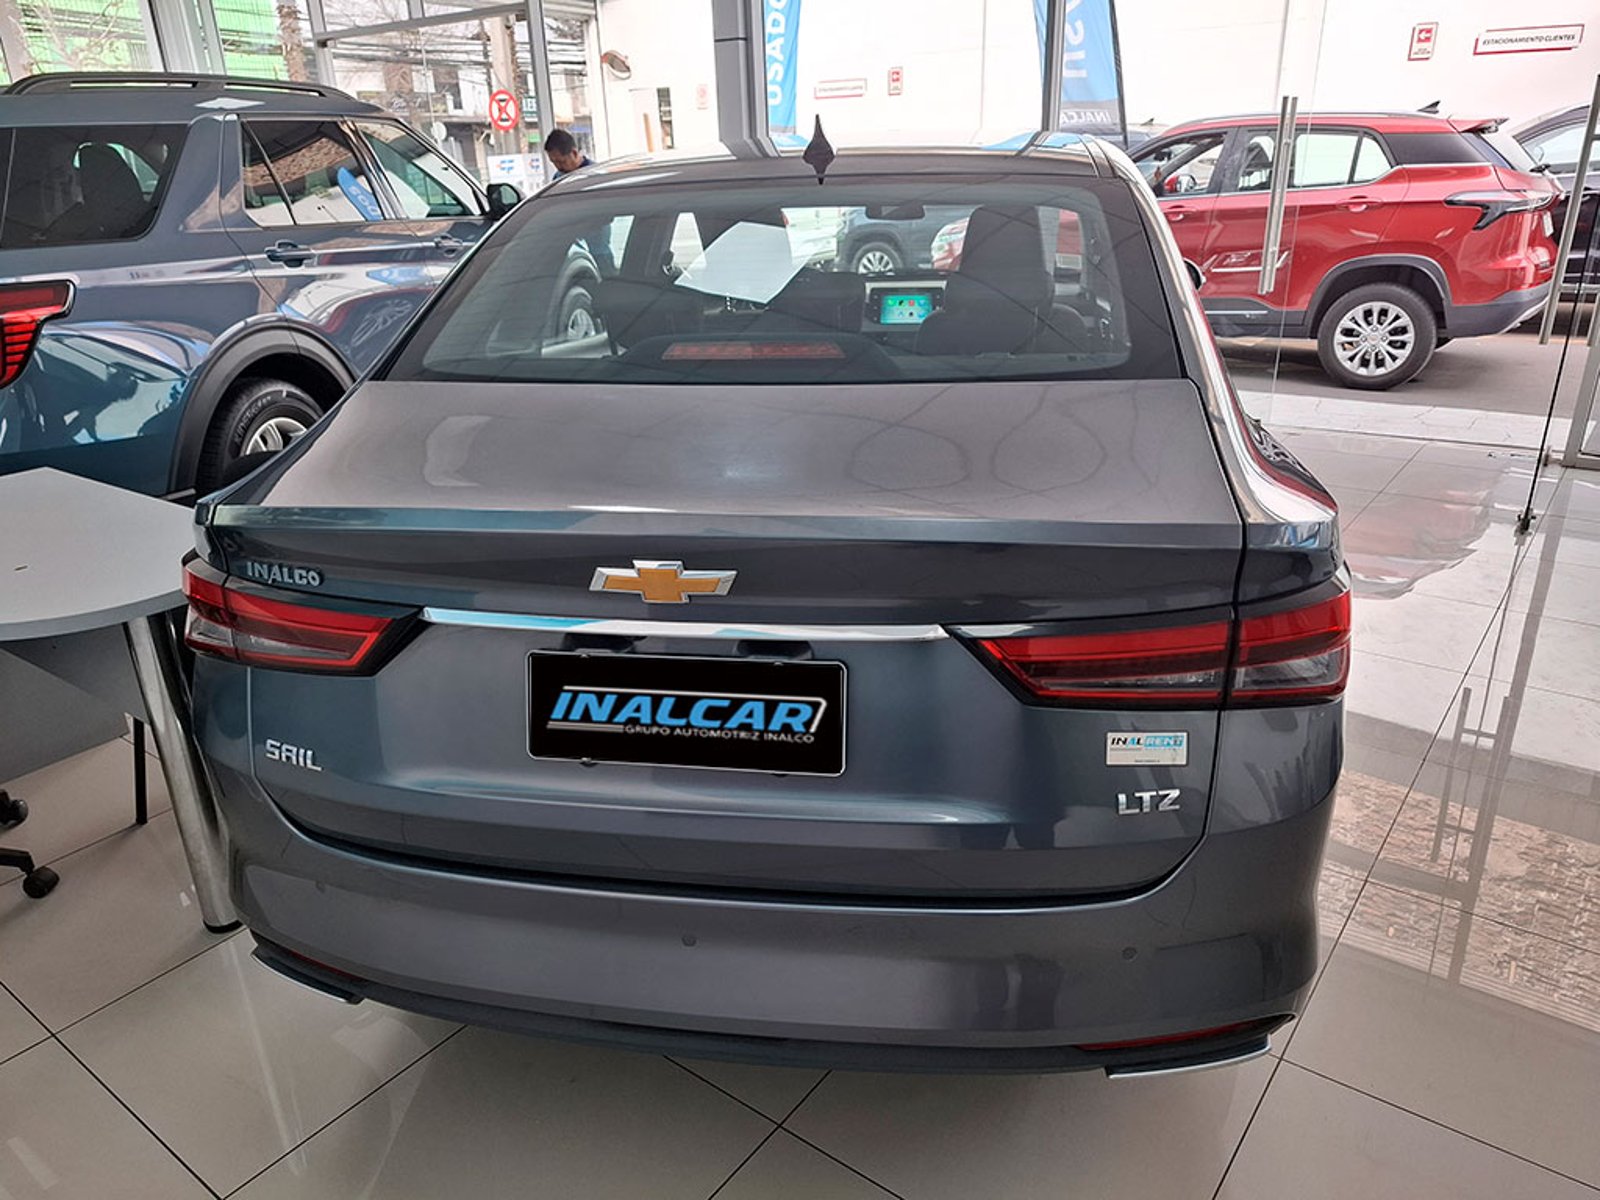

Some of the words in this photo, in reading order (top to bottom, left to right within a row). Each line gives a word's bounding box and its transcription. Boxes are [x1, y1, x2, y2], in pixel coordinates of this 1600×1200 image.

[1545, 33, 1576, 42] CLIENTES
[246, 561, 321, 587] INALCO
[549, 691, 814, 733] INALCAR
[625, 725, 671, 736] GRUPO
[673, 727, 760, 741] AUTOMOTRIZ
[763, 732, 815, 744] INALCO
[265, 738, 322, 772] SAIL
[1117, 788, 1181, 815] LTZ
